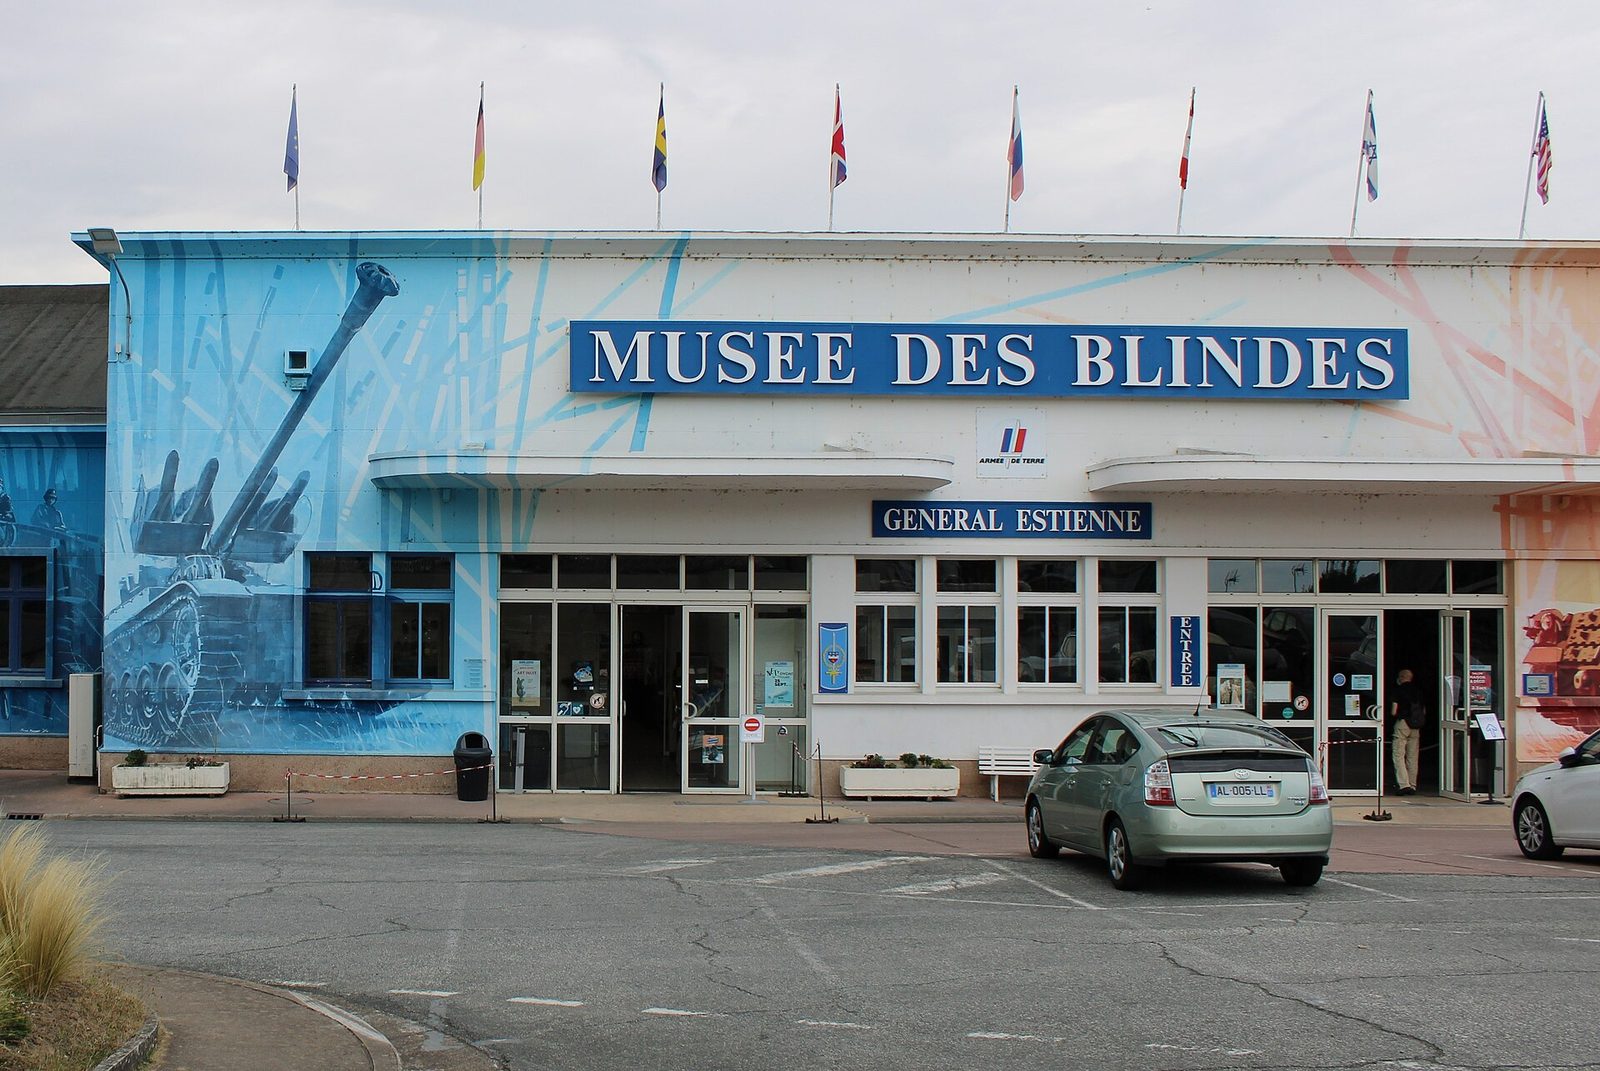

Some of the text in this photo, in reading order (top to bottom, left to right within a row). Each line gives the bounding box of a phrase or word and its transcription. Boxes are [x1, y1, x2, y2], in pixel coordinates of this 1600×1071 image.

[588, 330, 1395, 391] MUSEE DES BLINDES
[883, 508, 1142, 533] GENERAL ESTIENNE
[1179, 616, 1193, 686] ENTREE
[1217, 785, 1267, 796] AL-005-LL
